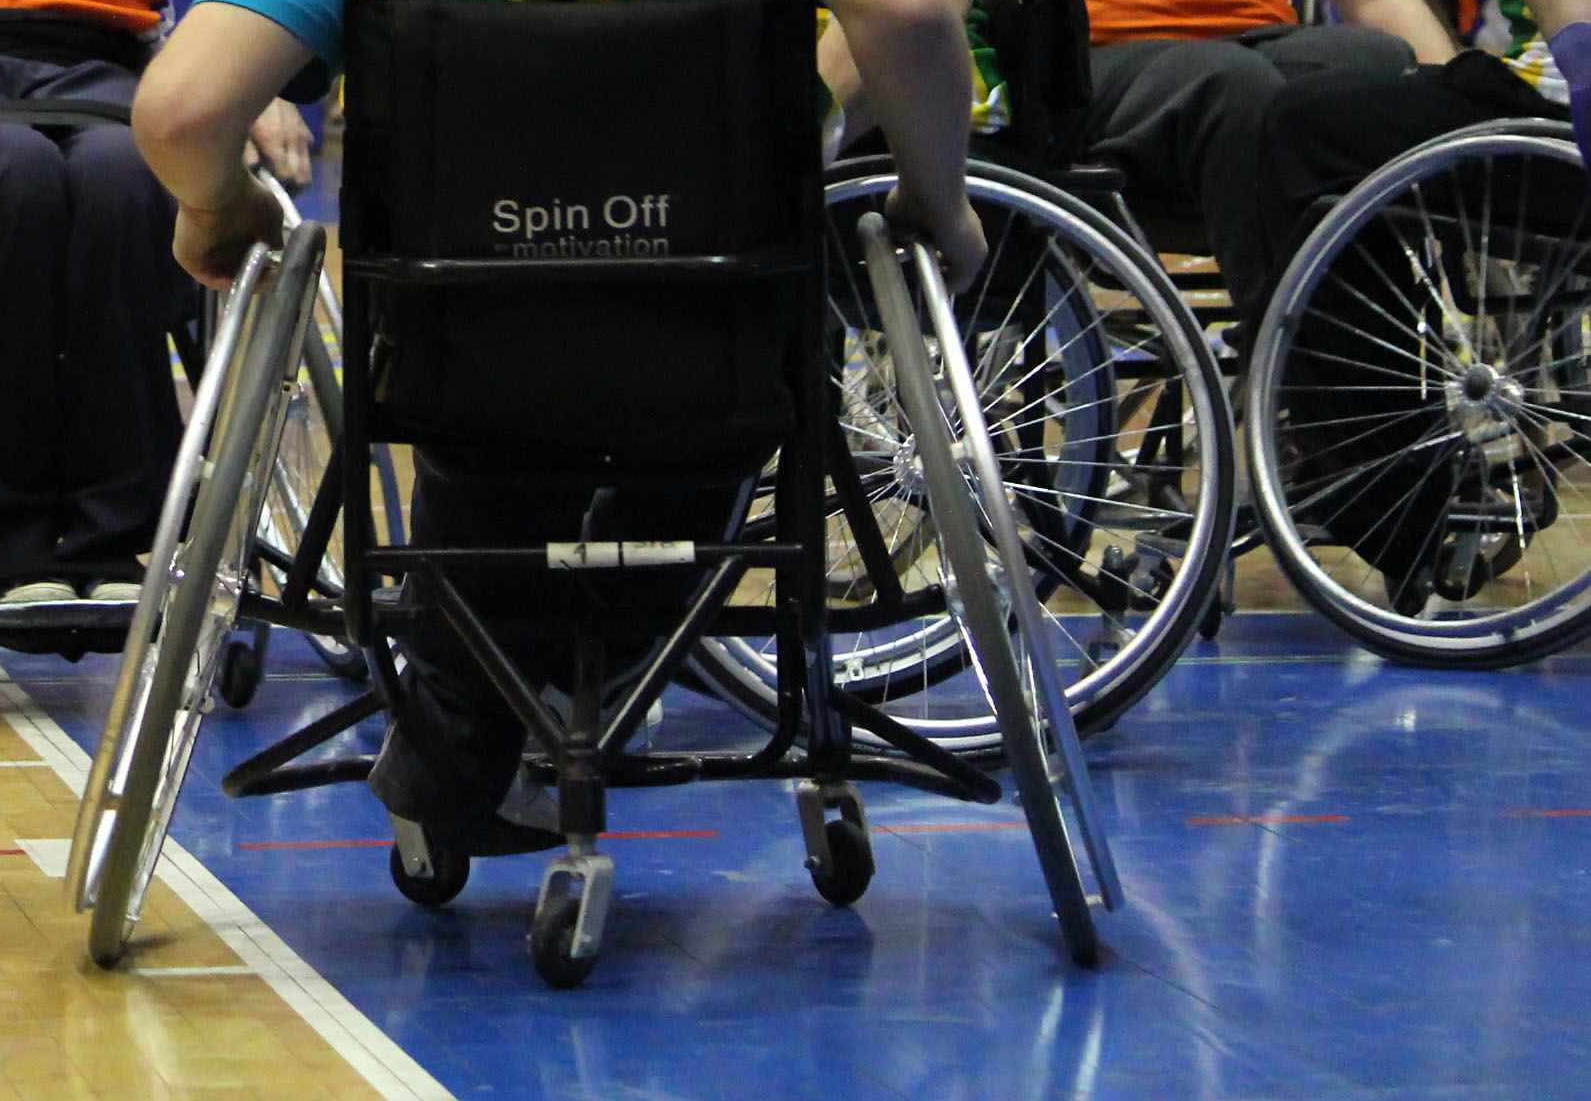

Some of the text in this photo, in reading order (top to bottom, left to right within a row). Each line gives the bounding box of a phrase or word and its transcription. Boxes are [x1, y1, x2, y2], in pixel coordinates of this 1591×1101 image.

[493, 193, 671, 240] Spin Off
[512, 233, 670, 258] motivation
